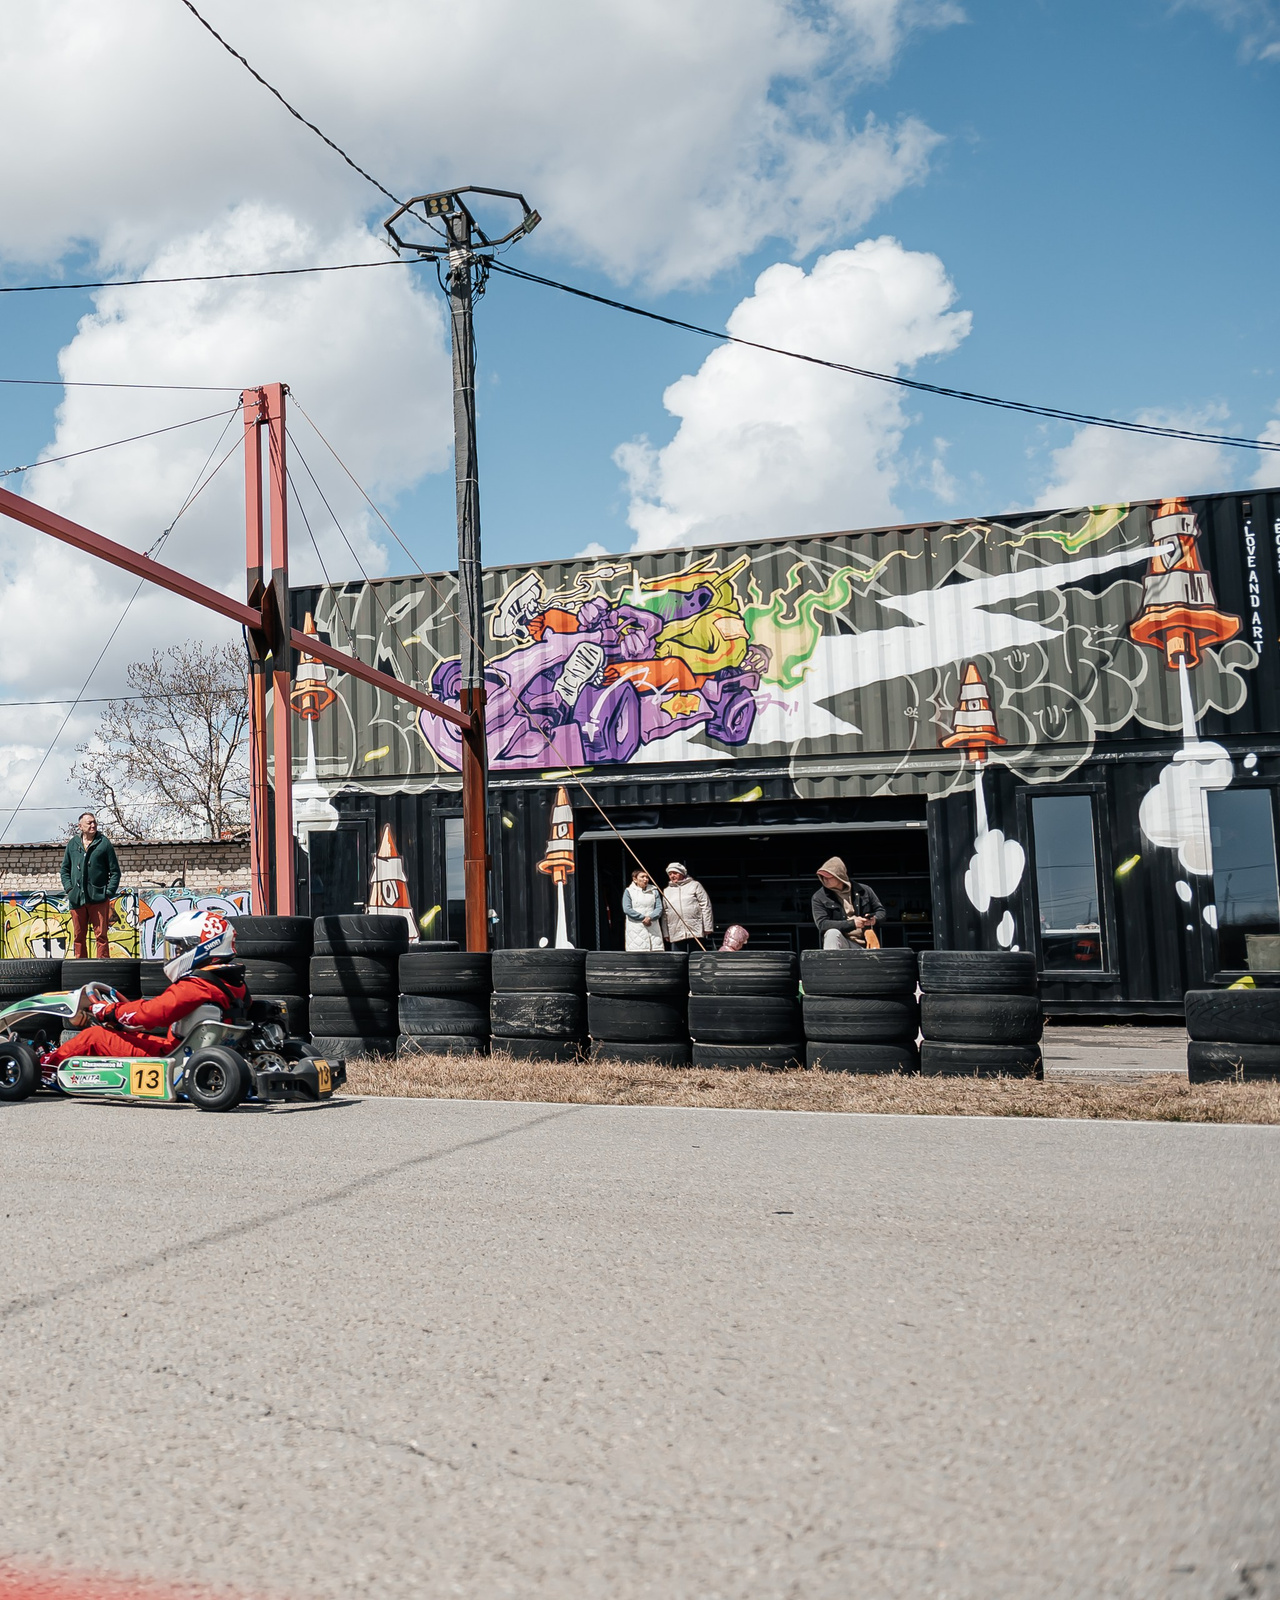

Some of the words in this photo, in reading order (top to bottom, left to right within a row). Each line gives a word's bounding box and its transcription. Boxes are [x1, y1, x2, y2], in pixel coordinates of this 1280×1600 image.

[1244, 525, 1256, 568] LOVE
[1248, 570, 1260, 608] AND
[1252, 611, 1264, 654] ART
[203, 917, 223, 939] 93
[135, 1069, 160, 1090] 13
[320, 1066, 329, 1086] 13
